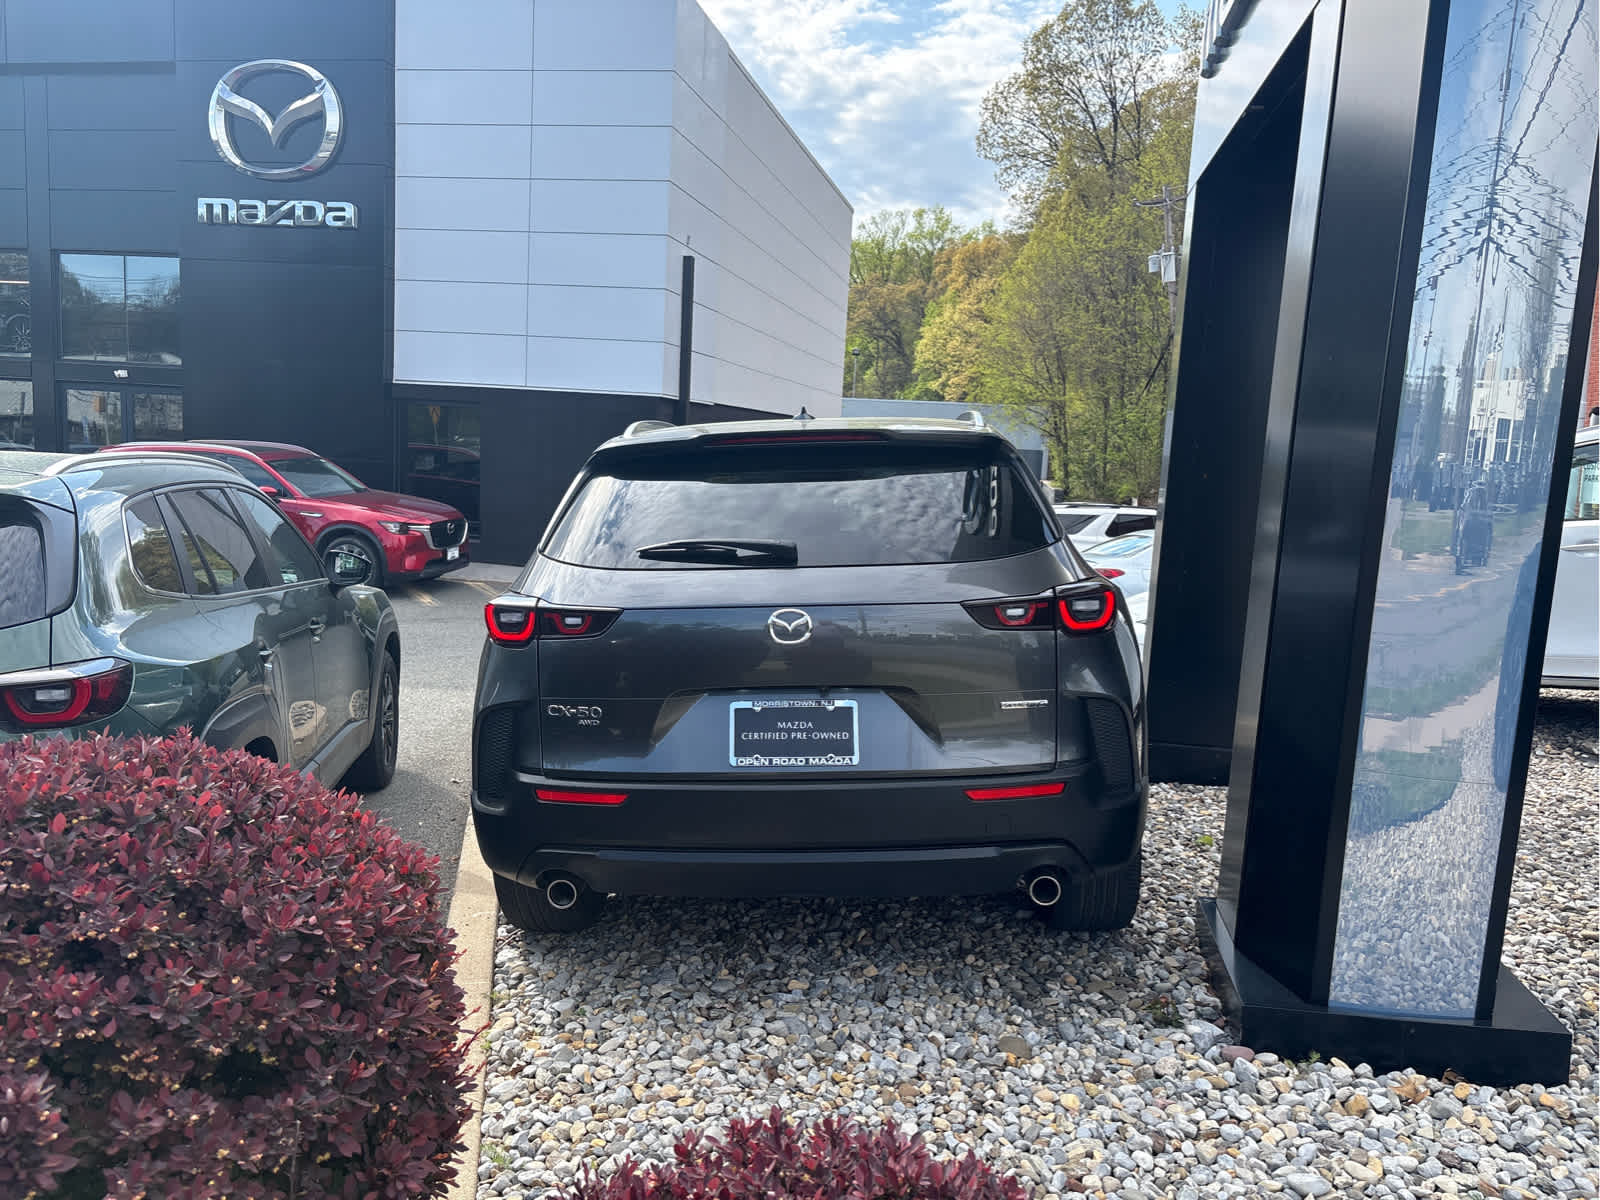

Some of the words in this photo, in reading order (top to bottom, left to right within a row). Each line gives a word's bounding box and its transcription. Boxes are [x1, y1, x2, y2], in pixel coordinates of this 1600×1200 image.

[197, 197, 357, 229] mazda
[548, 704, 602, 718] CX-50
[777, 721, 814, 729] MAZDA
[741, 732, 788, 740] CERTIFIED
[791, 731, 849, 740] PRE-OWNED
[737, 758, 769, 766] OPEN
[772, 758, 806, 766] ROAD
